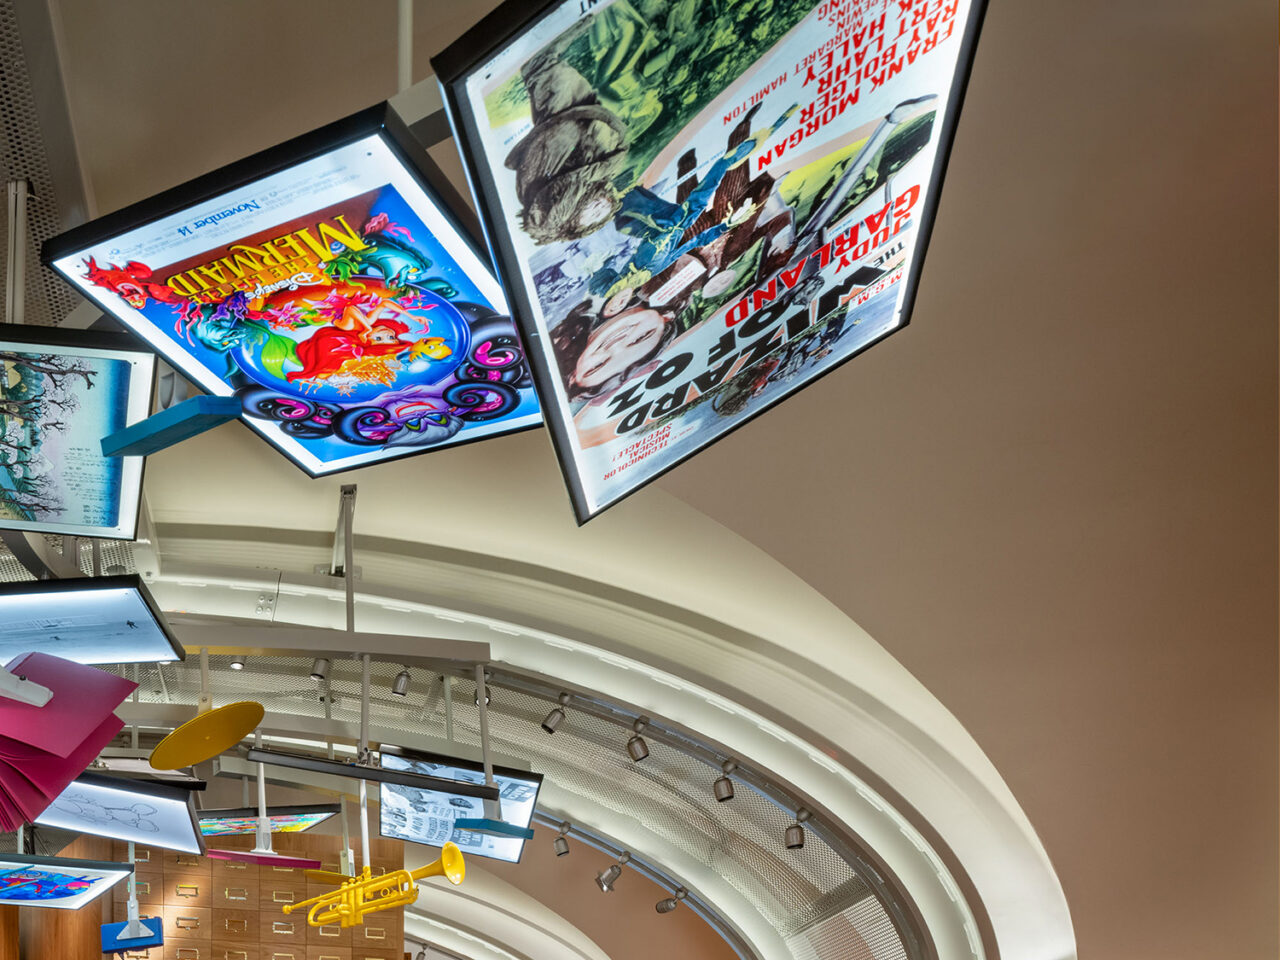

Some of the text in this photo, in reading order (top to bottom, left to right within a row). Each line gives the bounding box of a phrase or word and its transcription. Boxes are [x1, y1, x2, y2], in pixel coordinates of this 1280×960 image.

[723, 17, 863, 126] MARGARET HAMILTON
[799, 0, 960, 124] RAY BOLGER
[802, 12, 886, 88] HALEY
[817, 33, 884, 94] LAHR
[758, 19, 955, 171] FRANK MORGAN
[177, 224, 193, 237] 14
[194, 199, 261, 231] November
[834, 212, 910, 274] JUDY
[167, 214, 371, 297] MERMAID
[270, 256, 317, 279] THE
[725, 184, 920, 328] GARLAND
[873, 241, 905, 267] THE
[616, 265, 887, 434] WIZARD
[707, 300, 793, 366] OF
[607, 352, 694, 419] OZ
[604, 440, 668, 480] TECHNICOLOR
[612, 423, 672, 461] SPECTACLE!
[629, 431, 671, 458] MUSICAL
